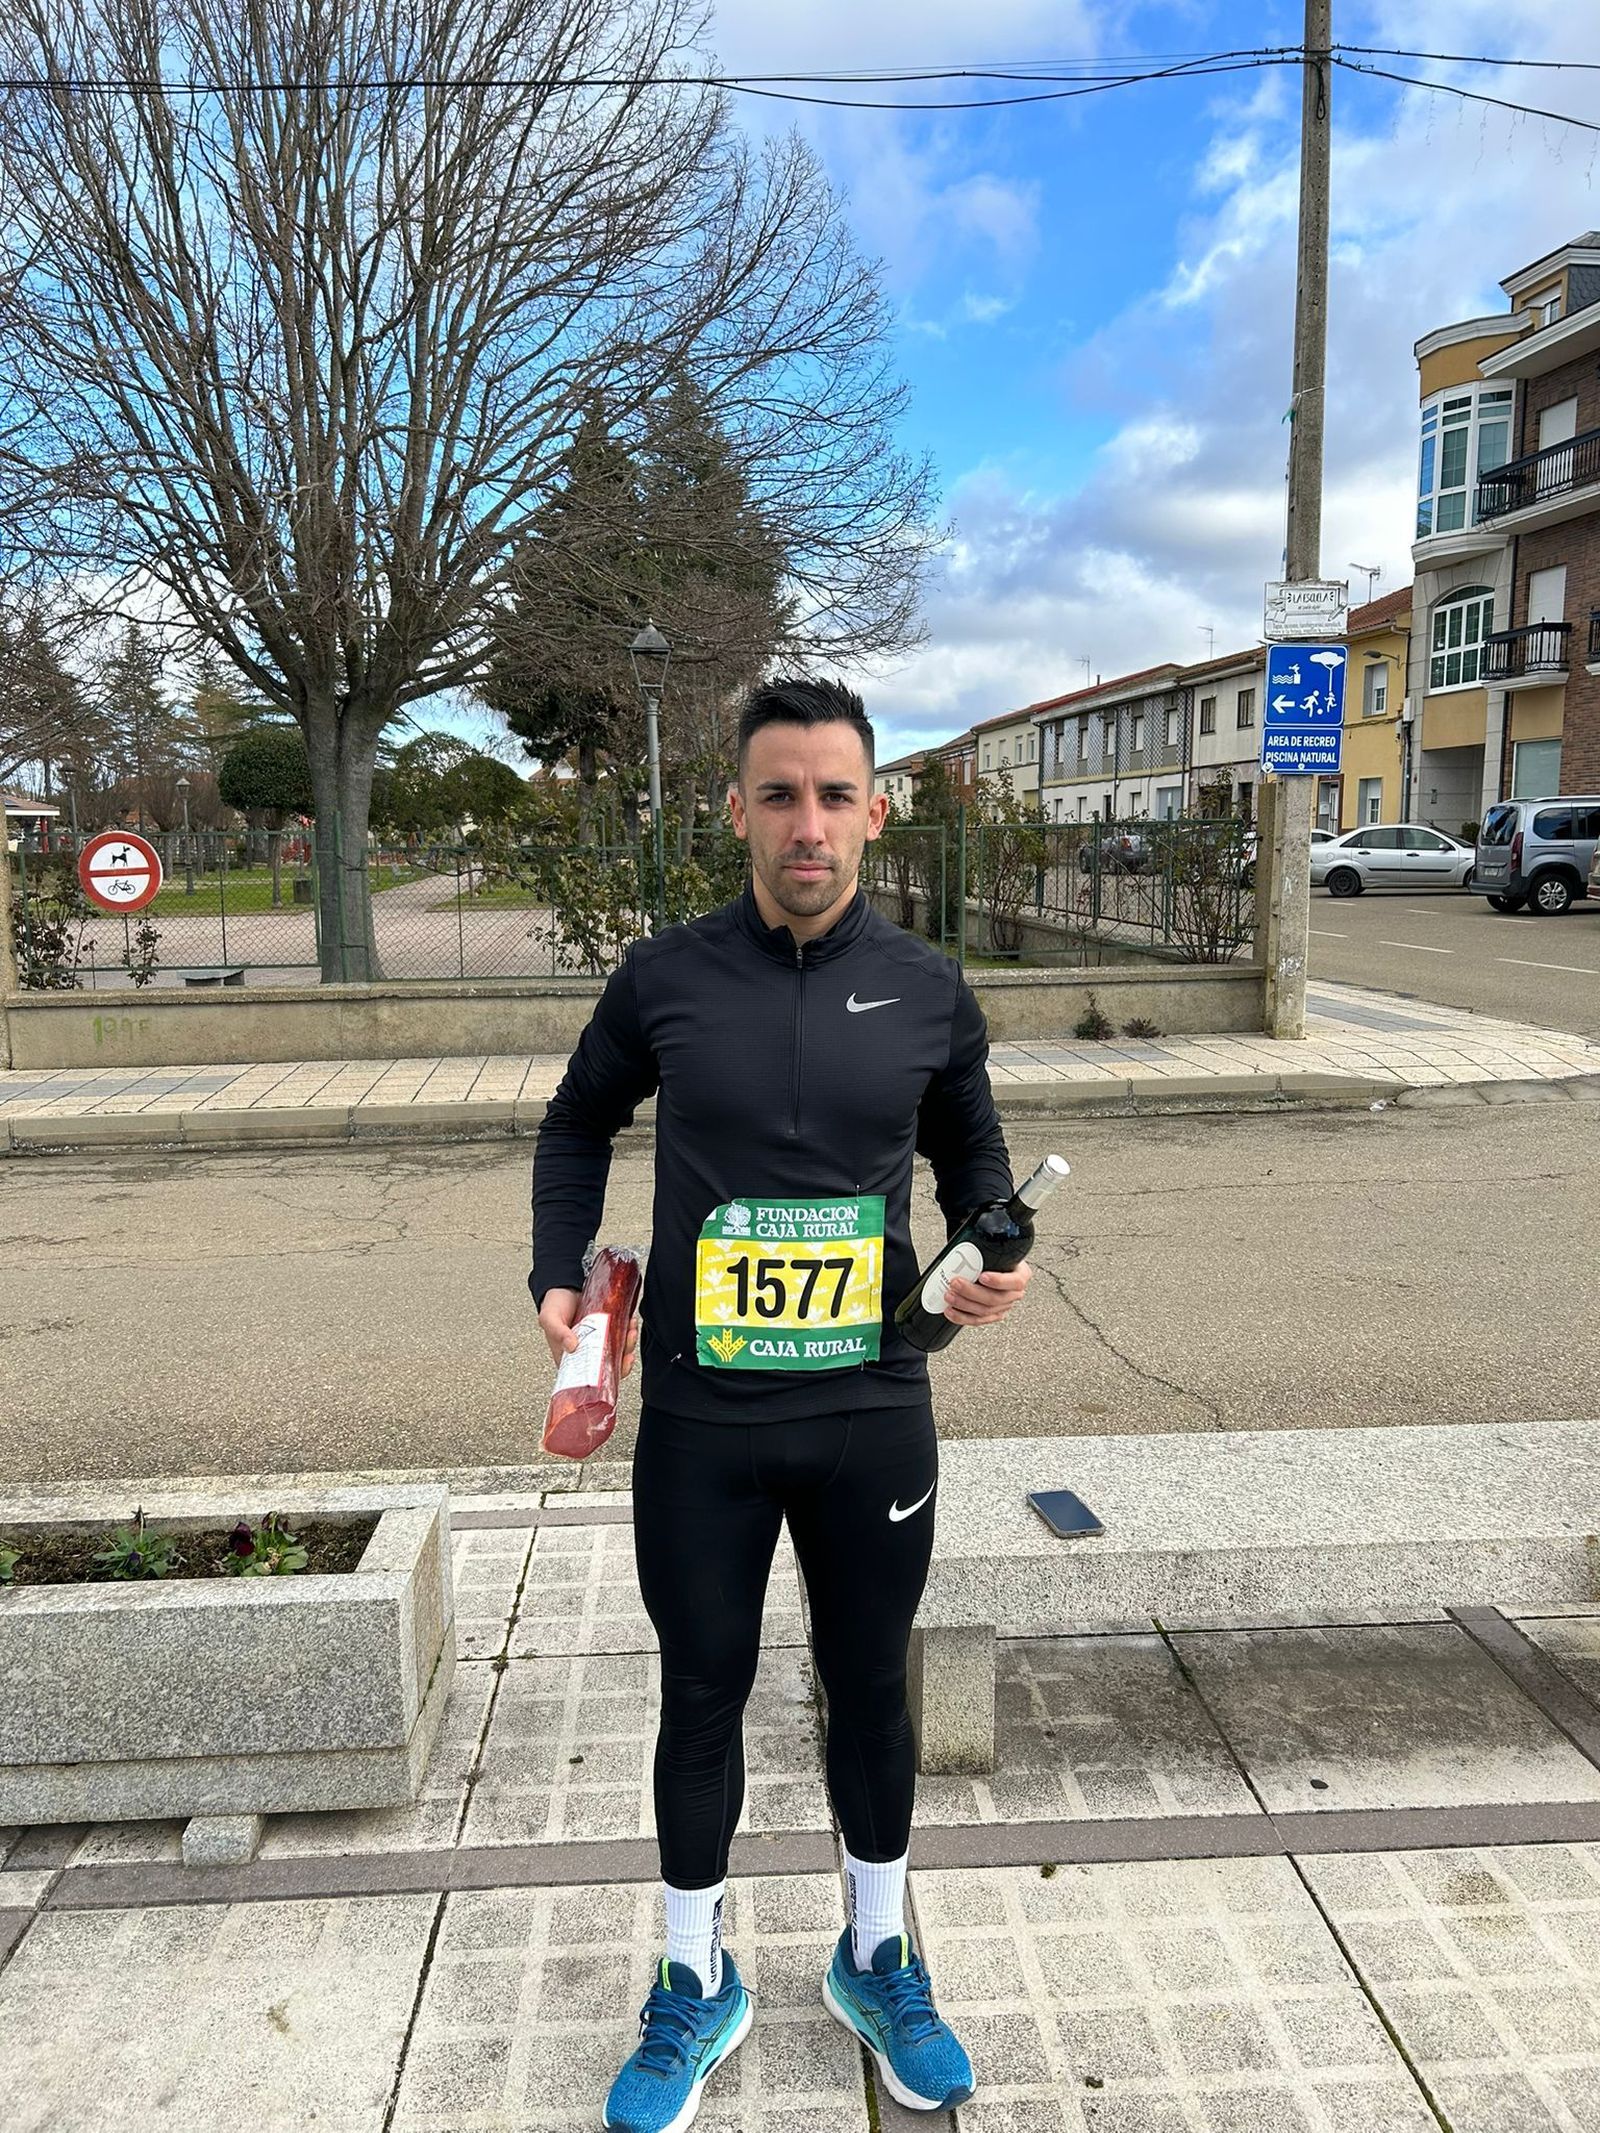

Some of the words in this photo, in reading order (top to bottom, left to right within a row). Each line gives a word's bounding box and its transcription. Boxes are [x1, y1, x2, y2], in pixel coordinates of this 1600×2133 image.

[1267, 735, 1289, 747] AREA
[1290, 735, 1303, 747] DE
[1303, 736, 1336, 747] RECREO
[1265, 752, 1299, 763] PISCINA
[1300, 752, 1337, 763] NATURAL
[756, 1205, 860, 1222] FUNDACION
[756, 1223, 799, 1239] CAJA
[803, 1222, 858, 1238] RURAL
[726, 1255, 854, 1320] 1577
[750, 1339, 800, 1358] CAJA
[804, 1337, 866, 1357] RURAL
